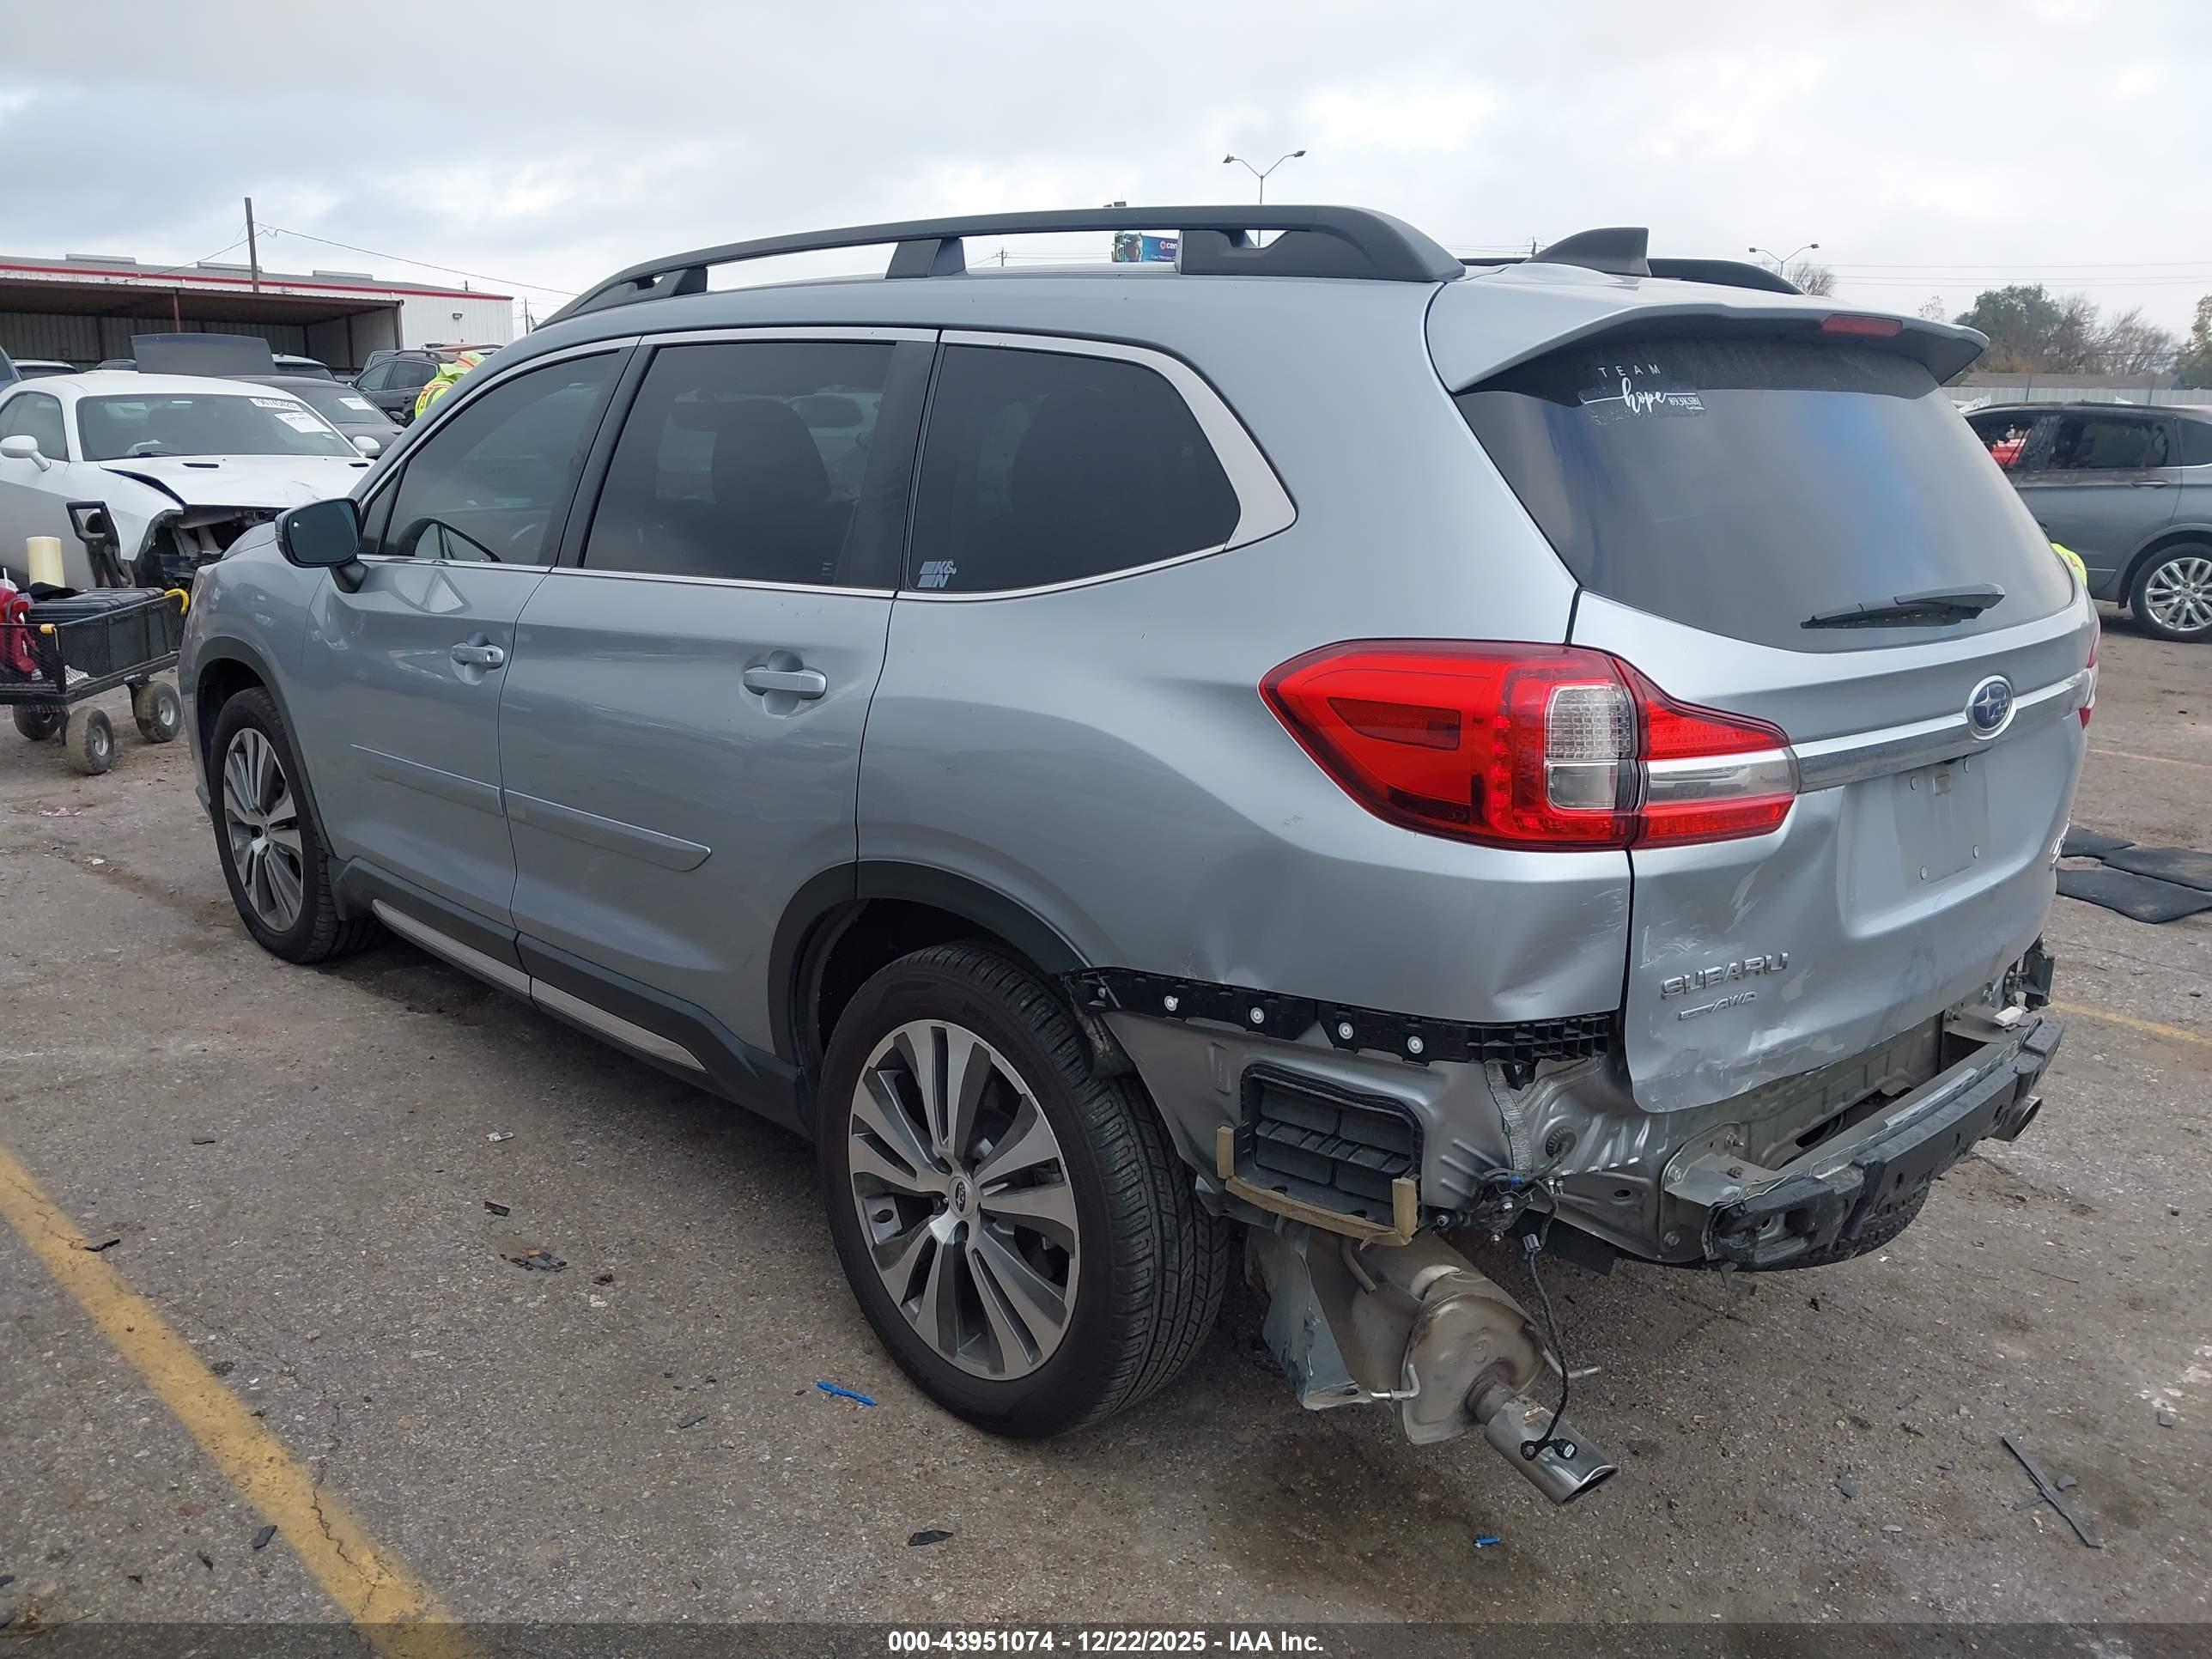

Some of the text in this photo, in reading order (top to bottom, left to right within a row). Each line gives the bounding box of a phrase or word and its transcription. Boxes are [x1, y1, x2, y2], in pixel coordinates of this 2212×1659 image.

[1597, 363, 1662, 379] TEAM
[1620, 376, 1667, 414] hope
[1661, 951, 1790, 1000] SUBARU
